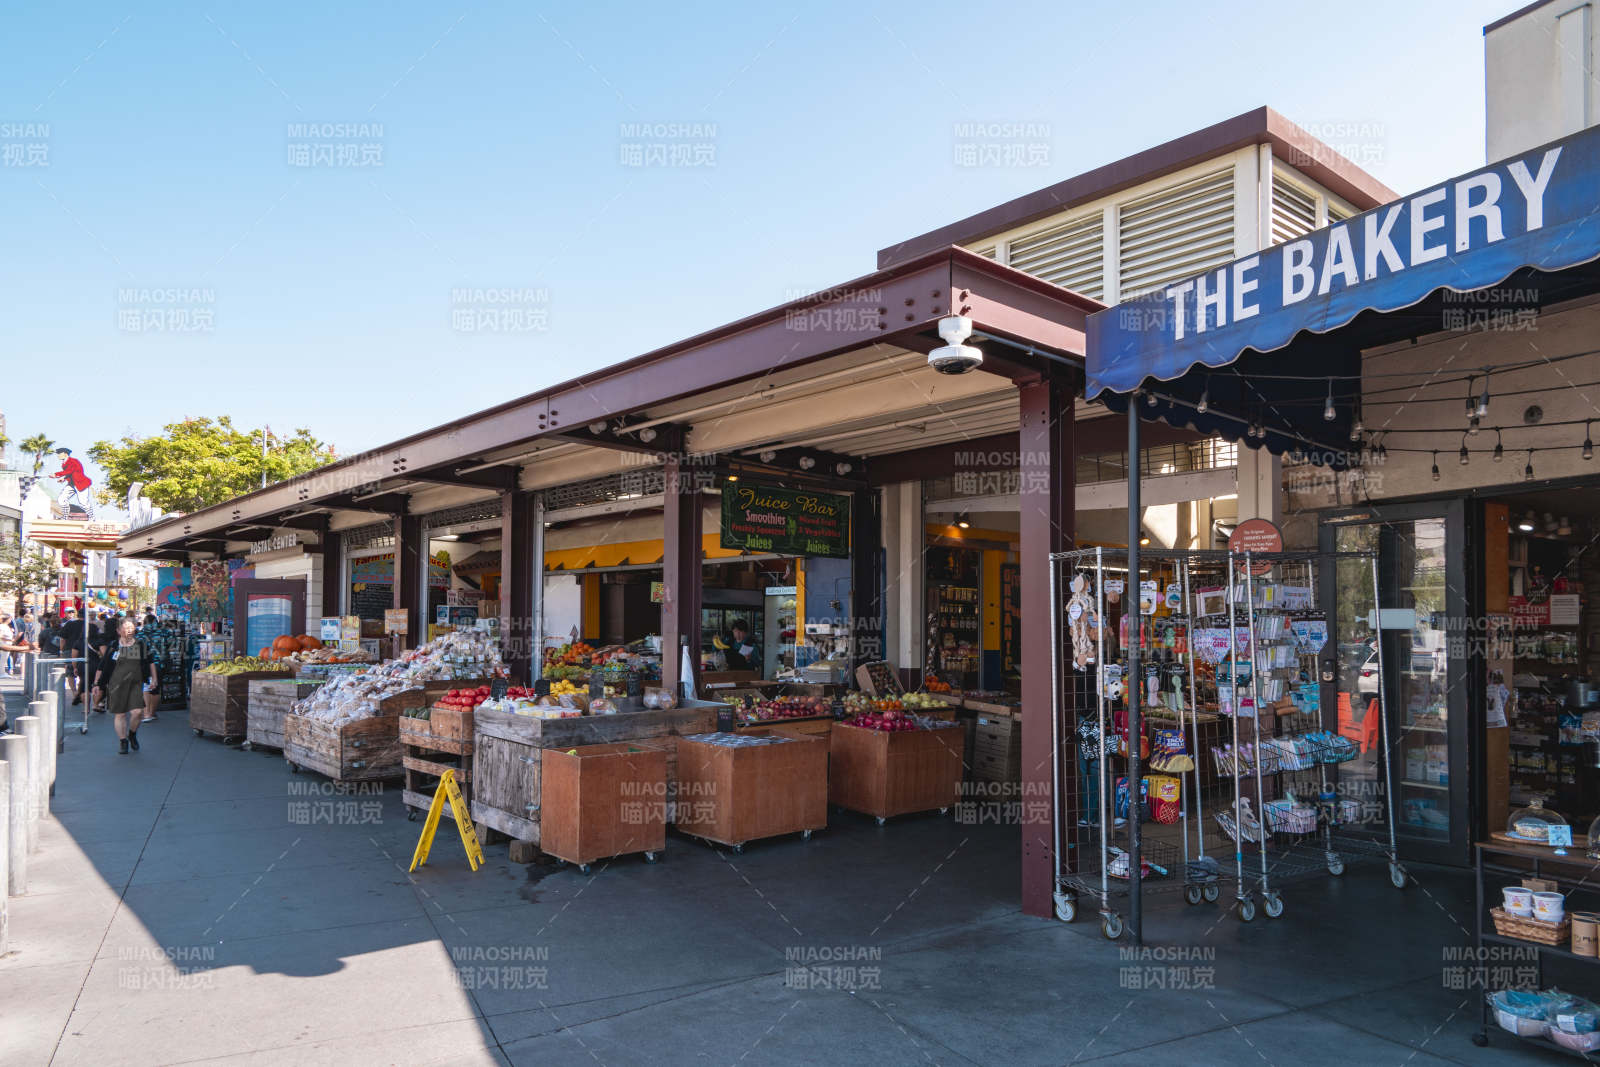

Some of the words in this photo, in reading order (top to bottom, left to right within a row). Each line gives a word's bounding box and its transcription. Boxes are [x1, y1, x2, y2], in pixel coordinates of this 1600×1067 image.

[1166, 256, 1260, 341] THE
[1282, 146, 1564, 306] BAKERY
[738, 488, 792, 511] Juice
[795, 495, 839, 517] Bar
[745, 510, 786, 525] Smoothies
[250, 541, 271, 555] POSTAL
[272, 533, 297, 550] CENTER
[745, 534, 773, 550] Juices
[806, 539, 831, 555] Juices
[1212, 641, 1229, 649] GIRL
